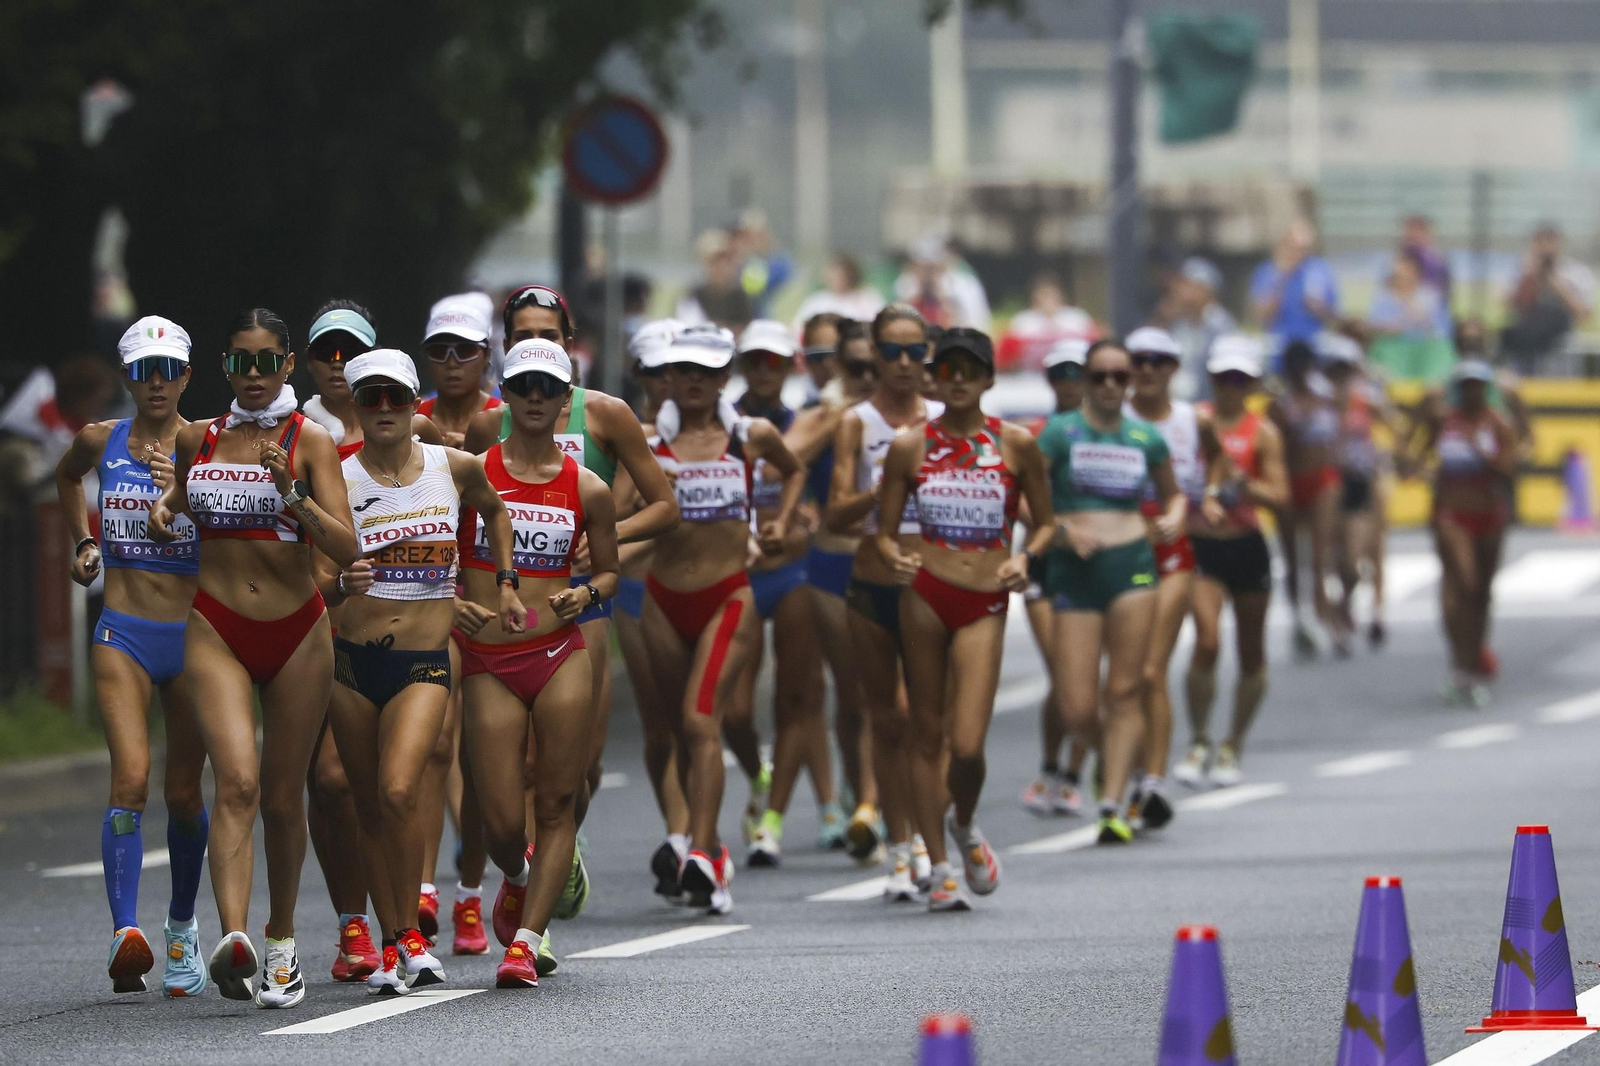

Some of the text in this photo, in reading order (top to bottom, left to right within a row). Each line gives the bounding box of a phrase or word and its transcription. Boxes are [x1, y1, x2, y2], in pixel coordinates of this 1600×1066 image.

[435, 315, 468, 326] CHINA
[520, 350, 557, 362] CHINA
[190, 469, 275, 483] HONDA
[680, 469, 740, 480] ONDA
[189, 489, 276, 512] GARCÍA LEÓN 163
[678, 487, 724, 503] NDIA
[922, 487, 1001, 500] HONDA
[104, 497, 156, 511] HON
[506, 508, 572, 526] ONDA
[363, 521, 454, 545] HONDA
[553, 539, 569, 553] 112
[380, 545, 454, 564] EREZ 126
